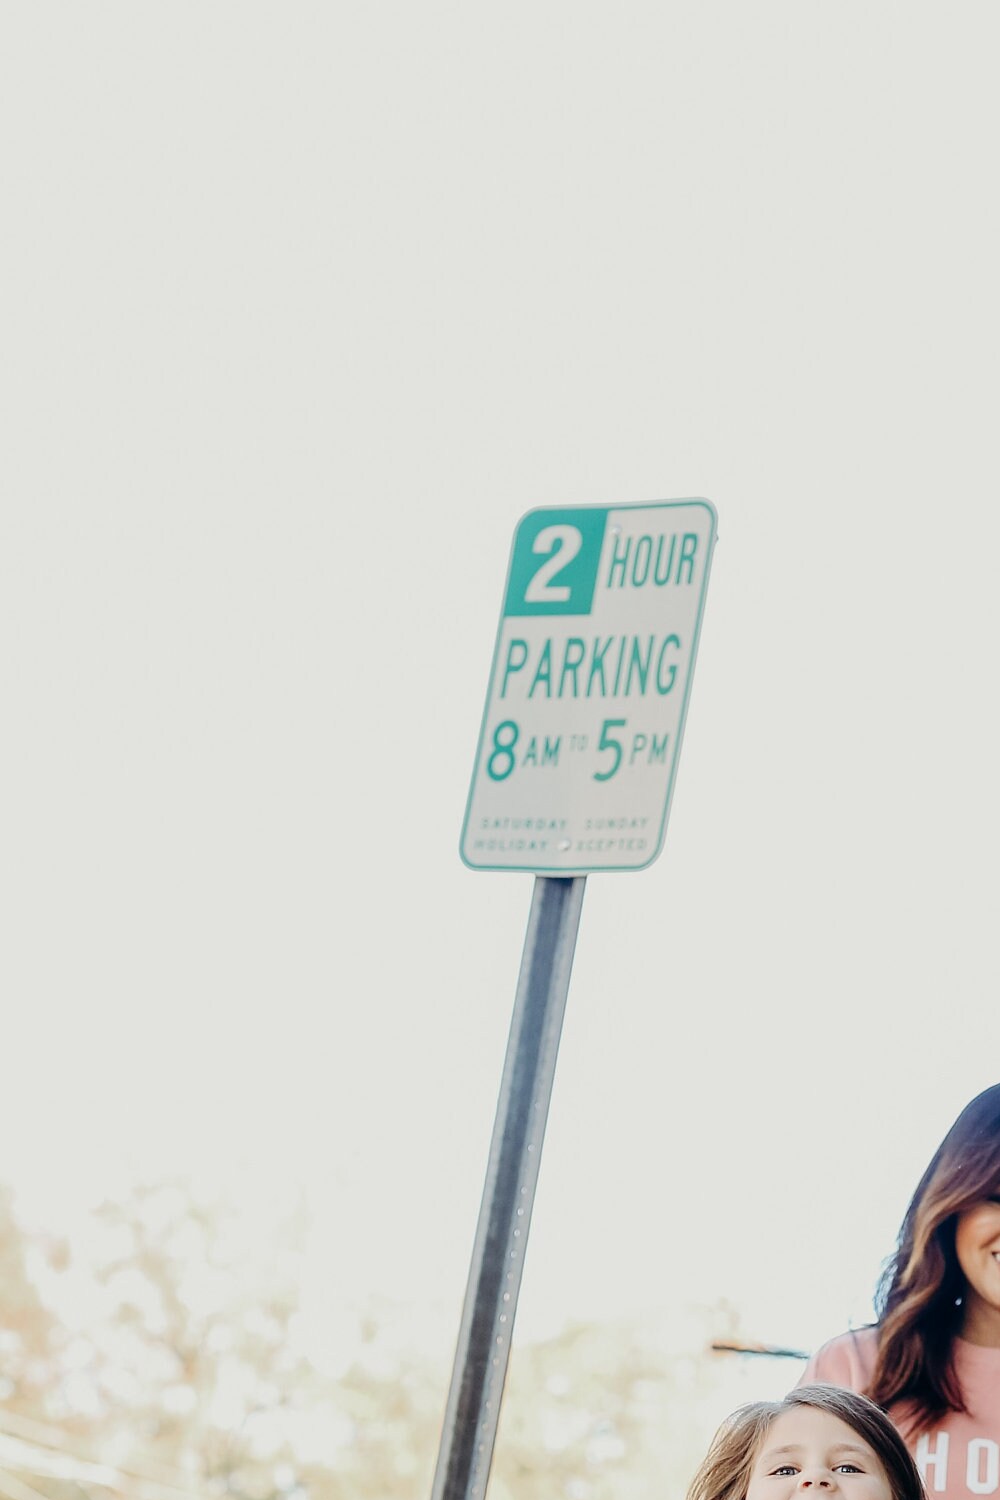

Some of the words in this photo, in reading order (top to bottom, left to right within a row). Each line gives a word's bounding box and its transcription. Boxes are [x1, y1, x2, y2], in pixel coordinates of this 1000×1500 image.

[523, 523, 583, 603] 2
[607, 532, 698, 588] HOUR
[500, 633, 681, 699] PARKING
